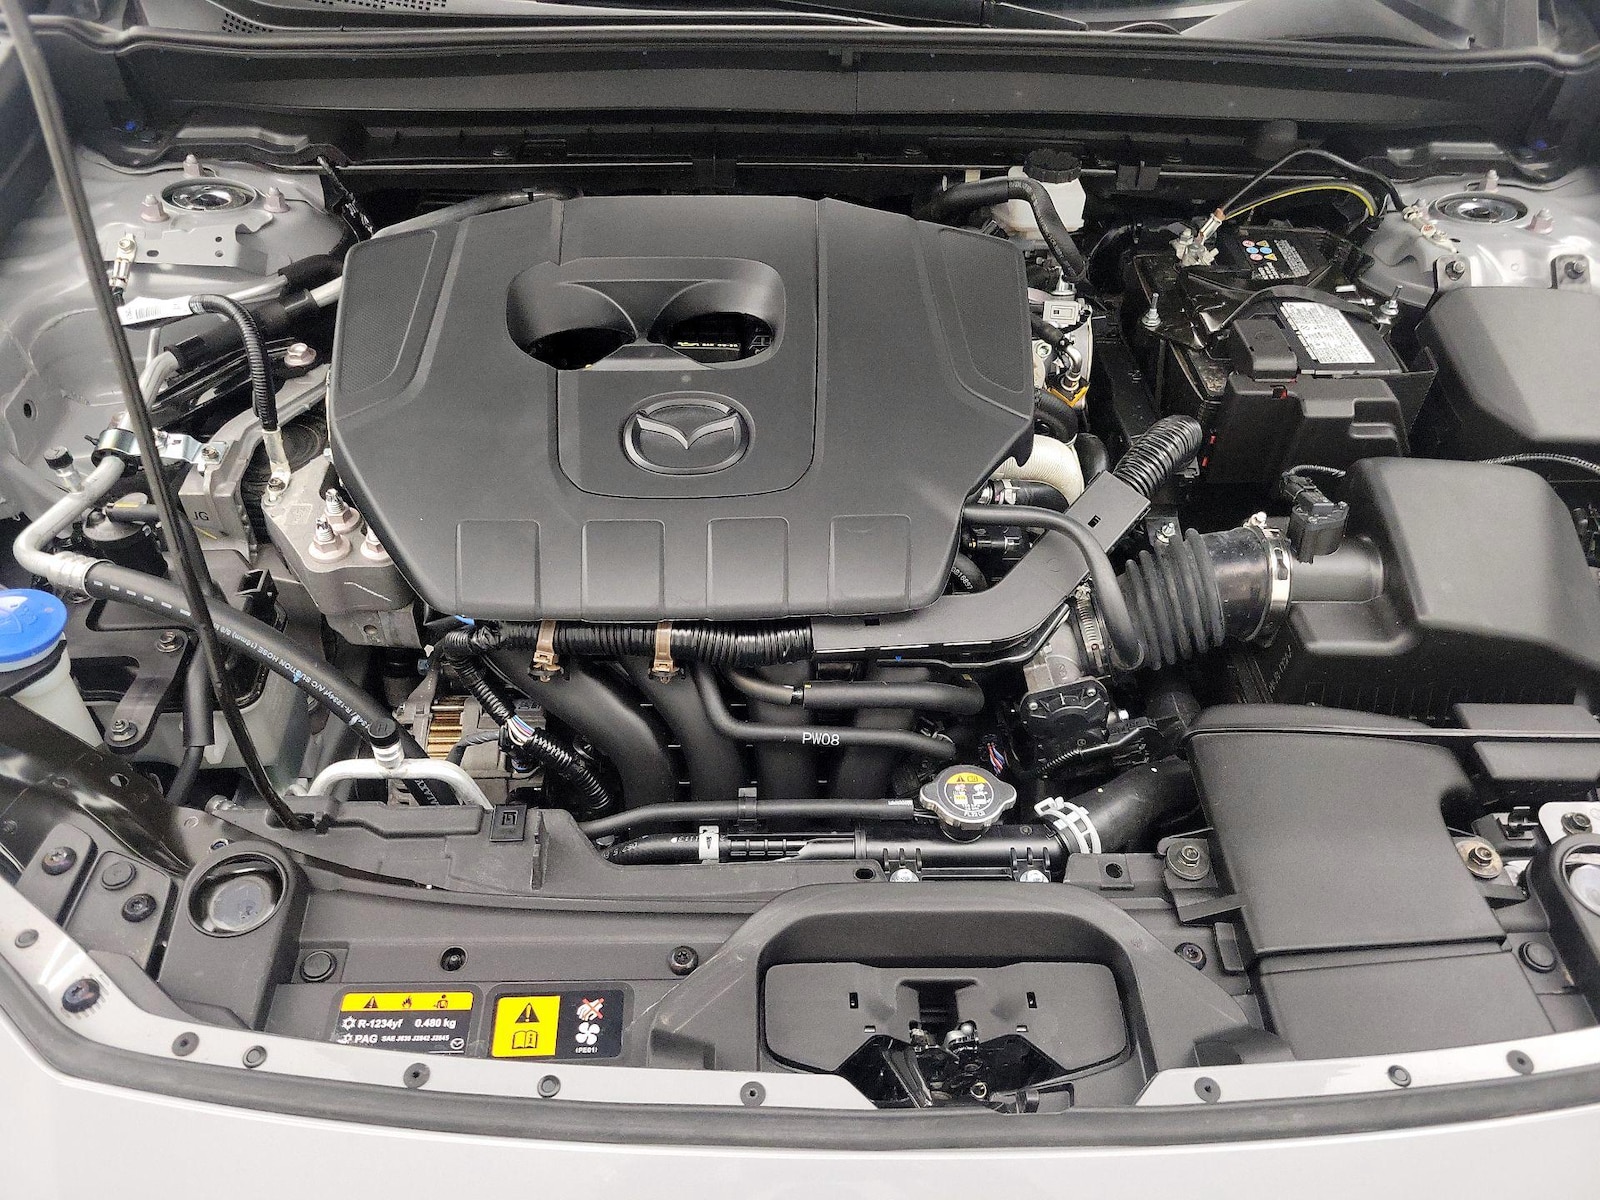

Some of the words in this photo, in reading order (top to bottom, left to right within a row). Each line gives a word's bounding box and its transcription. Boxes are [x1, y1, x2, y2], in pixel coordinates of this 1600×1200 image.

[193, 511, 209, 521] JG
[257, 646, 279, 663] HOSE
[311, 679, 326, 692] A/C
[324, 689, 352, 714] R-1234yf
[802, 732, 840, 746] PW08
[357, 1018, 404, 1030] R-1234yf
[414, 1018, 442, 1028] 0.480
[443, 1017, 457, 1030] kg
[355, 1034, 378, 1044] PAG
